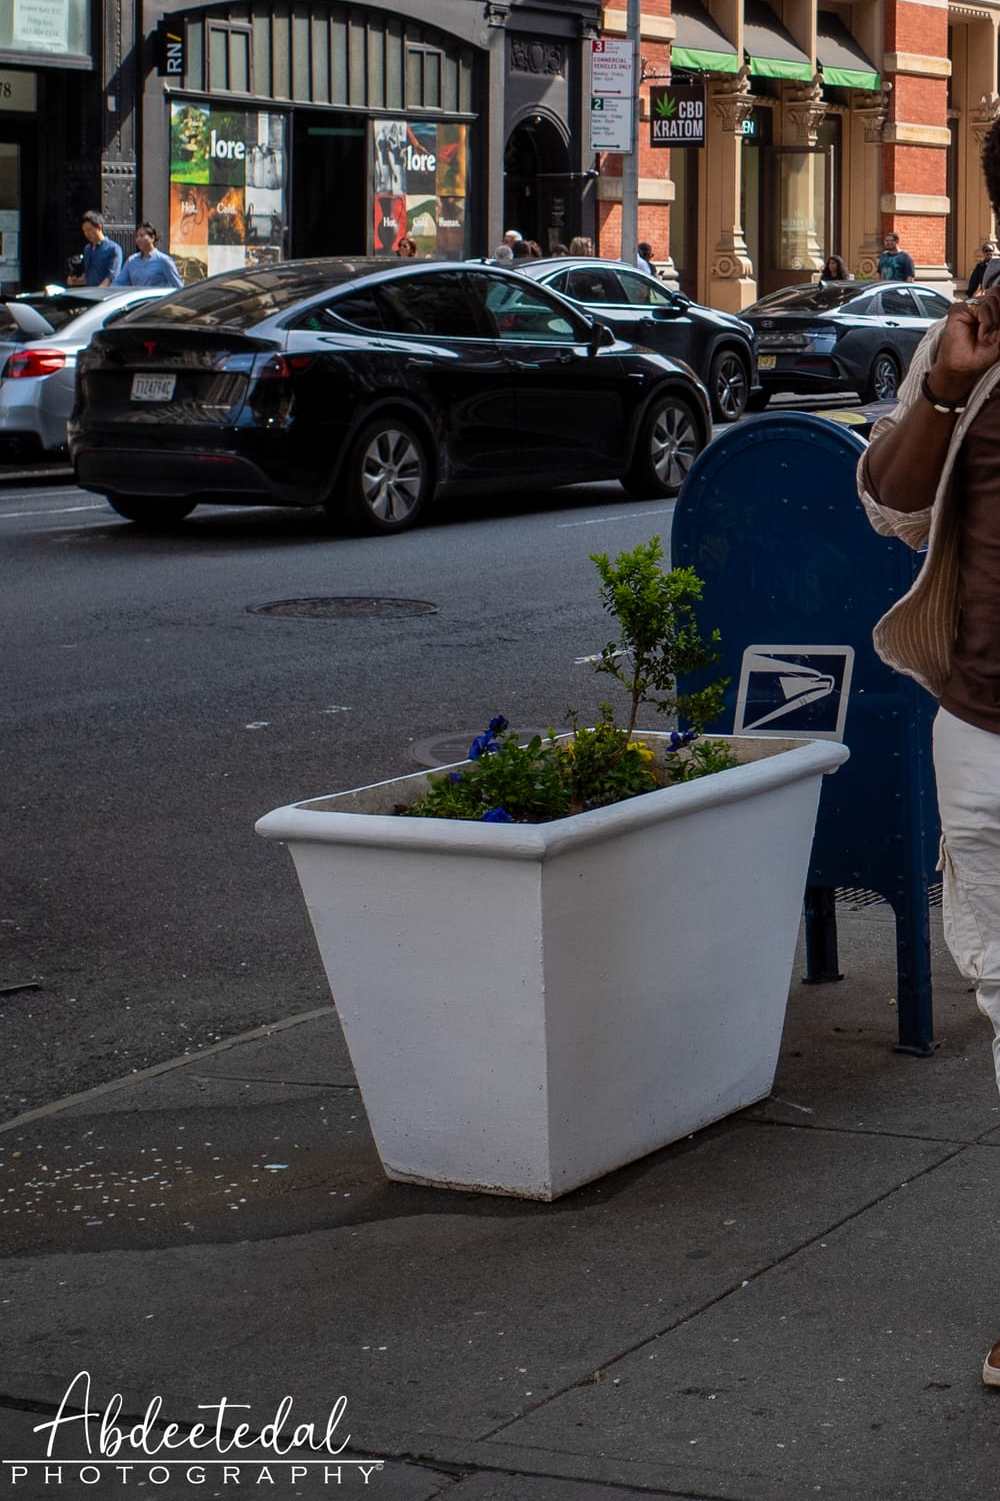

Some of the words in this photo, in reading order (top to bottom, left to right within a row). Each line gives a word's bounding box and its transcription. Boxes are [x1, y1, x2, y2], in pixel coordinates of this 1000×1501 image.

[595, 41, 602, 52] 3
[594, 99, 601, 110] 2
[678, 101, 703, 118] CBD
[653, 120, 703, 137] KRATOM
[210, 129, 245, 160] lore
[407, 145, 436, 171] lore
